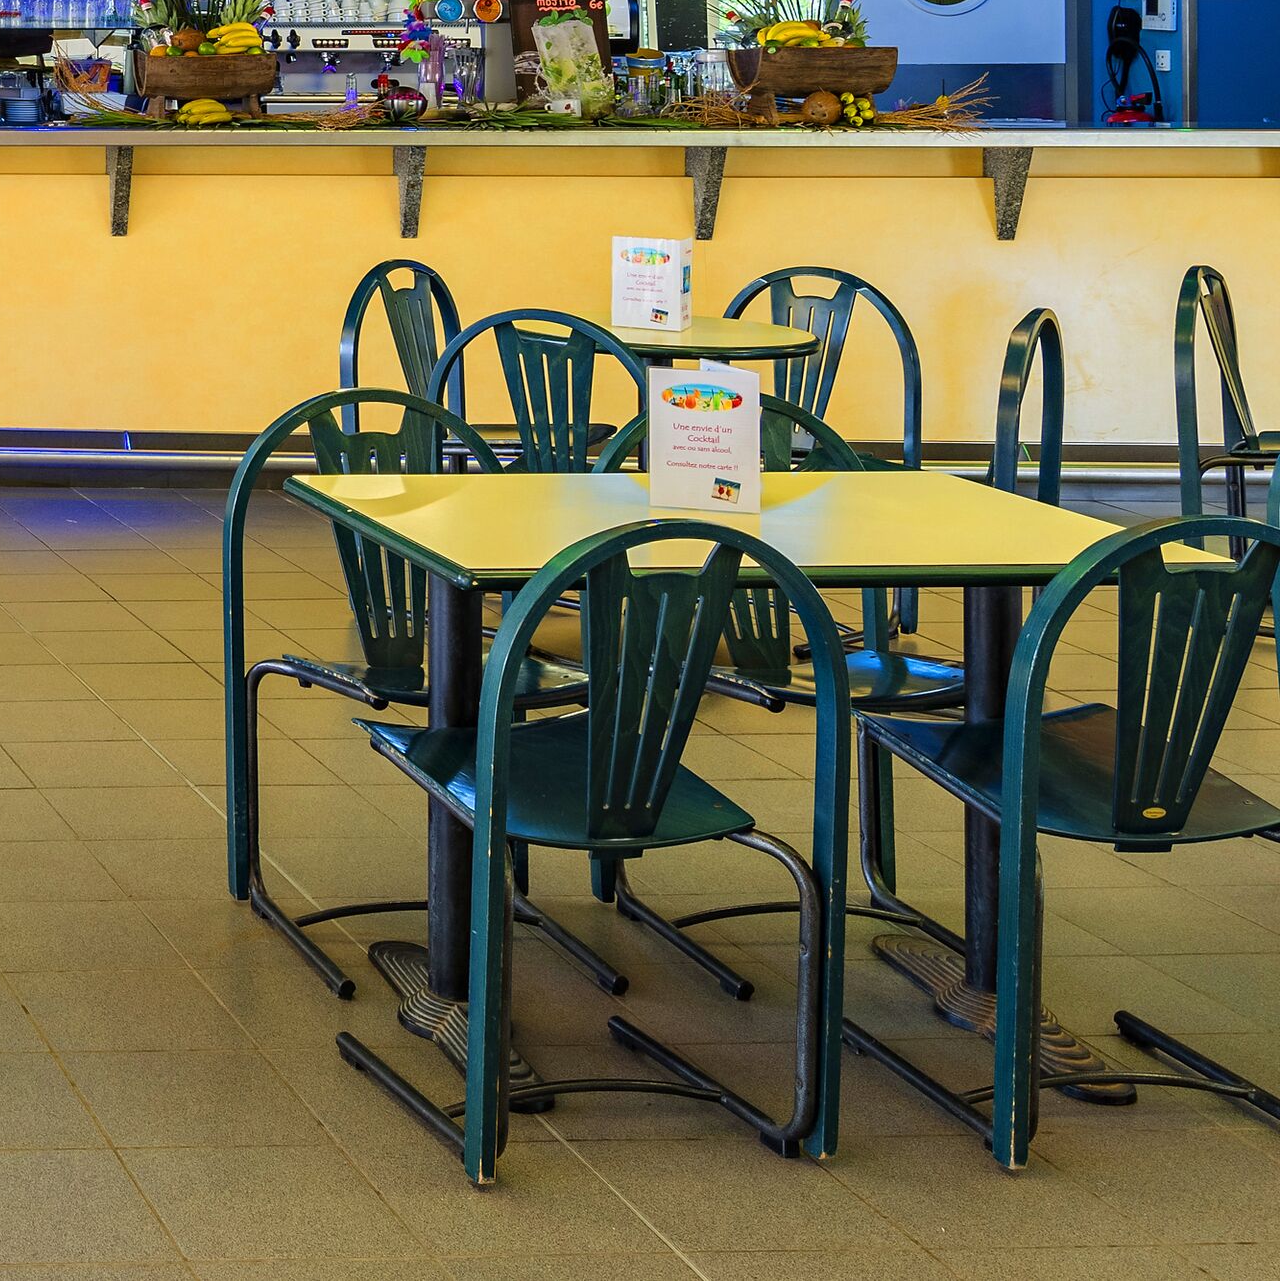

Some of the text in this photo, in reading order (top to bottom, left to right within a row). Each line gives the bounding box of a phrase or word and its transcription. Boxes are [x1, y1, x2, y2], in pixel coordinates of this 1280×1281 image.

[673, 422, 732, 434] Une envie d'un
[687, 434, 720, 444] Cocktail
[666, 460, 698, 469] Consultez
